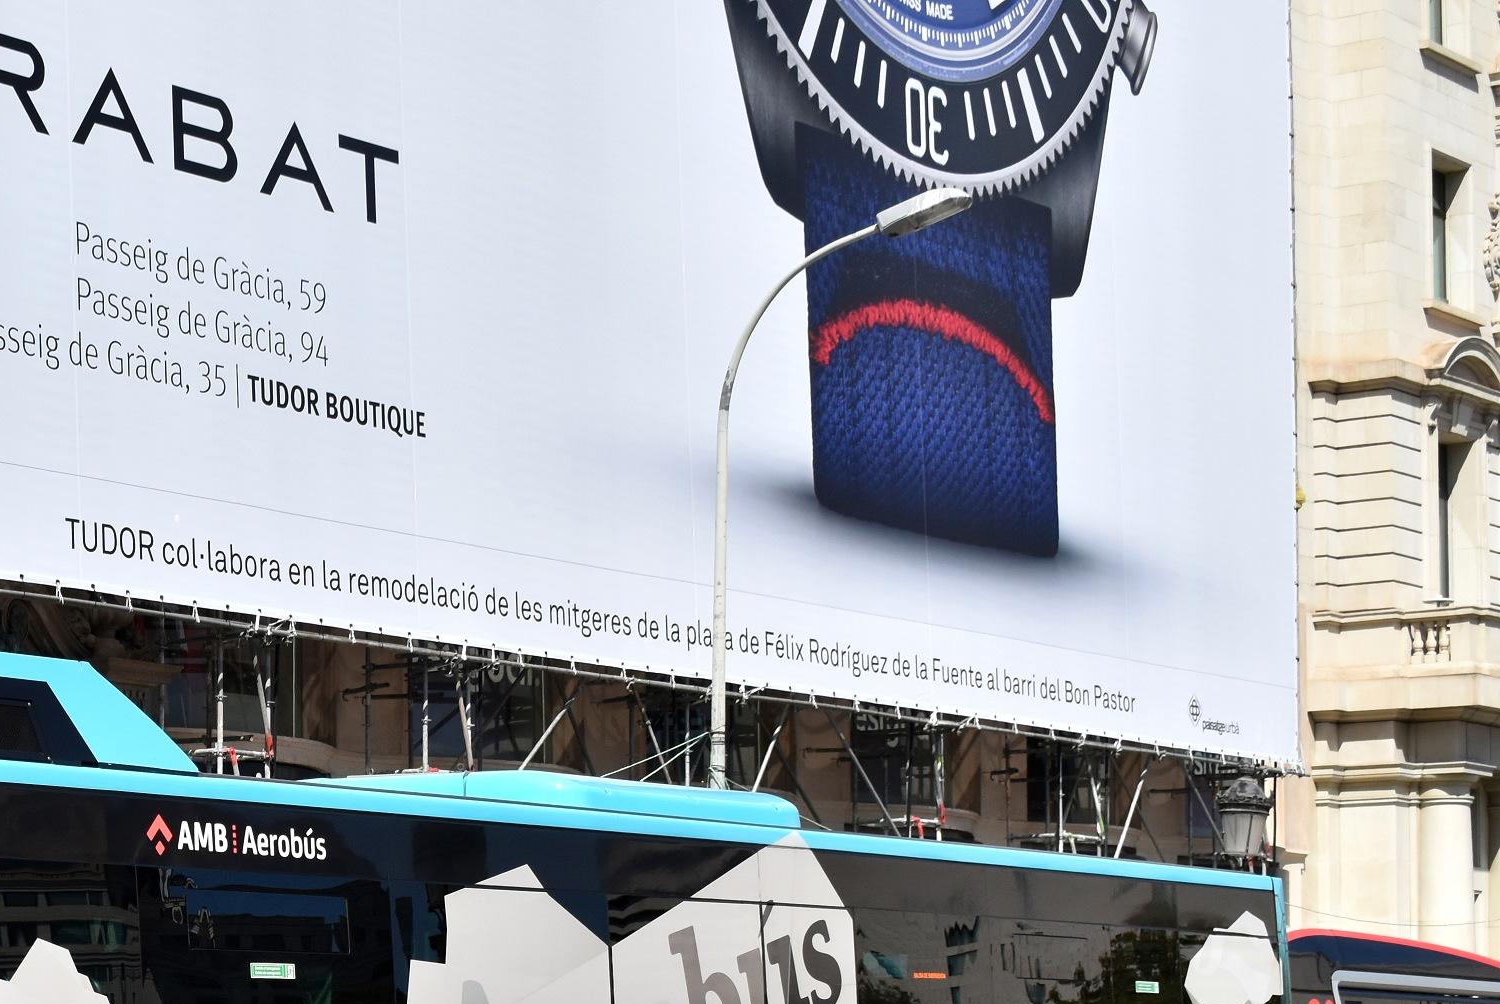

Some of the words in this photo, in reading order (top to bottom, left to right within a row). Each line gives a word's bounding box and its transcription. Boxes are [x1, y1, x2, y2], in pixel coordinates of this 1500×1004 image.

[925, 0, 954, 20] MADE
[75, 221, 168, 284] Passeig
[176, 247, 205, 284] de
[213, 256, 292, 311] Gràcia,
[299, 279, 327, 314] 59
[76, 277, 171, 338] Passeig
[177, 301, 207, 339] de
[215, 311, 293, 364] Gràcia,
[301, 332, 329, 367] 94
[68, 332, 98, 370] de
[107, 341, 191, 395] Gràcia,
[199, 361, 227, 396] 35
[247, 374, 320, 416] TUDOR
[325, 392, 426, 438] BOUTIQUE
[64, 517, 155, 564] TUDOR
[162, 538, 281, 583] col·labora
[289, 562, 316, 587] en
[321, 560, 342, 592] la
[348, 573, 479, 612] remodelació
[485, 588, 509, 617] de
[515, 592, 543, 623] les
[548, 601, 631, 640] mitgeres
[638, 612, 659, 639] de
[665, 615, 680, 642] la
[687, 620, 733, 651] plaa
[739, 628, 759, 654] de
[765, 632, 804, 663] Félix
[809, 640, 887, 677] Rodríguez
[891, 652, 910, 677] de
[914, 653, 928, 680] la
[932, 657, 982, 688] Fuente
[987, 664, 1000, 692] al
[1003, 666, 1036, 697] barri
[1040, 673, 1060, 700] del
[1064, 679, 1091, 706] Bon
[1094, 684, 1136, 713] Pastor
[177, 820, 229, 854] AMB
[242, 826, 327, 861] Aerobús
